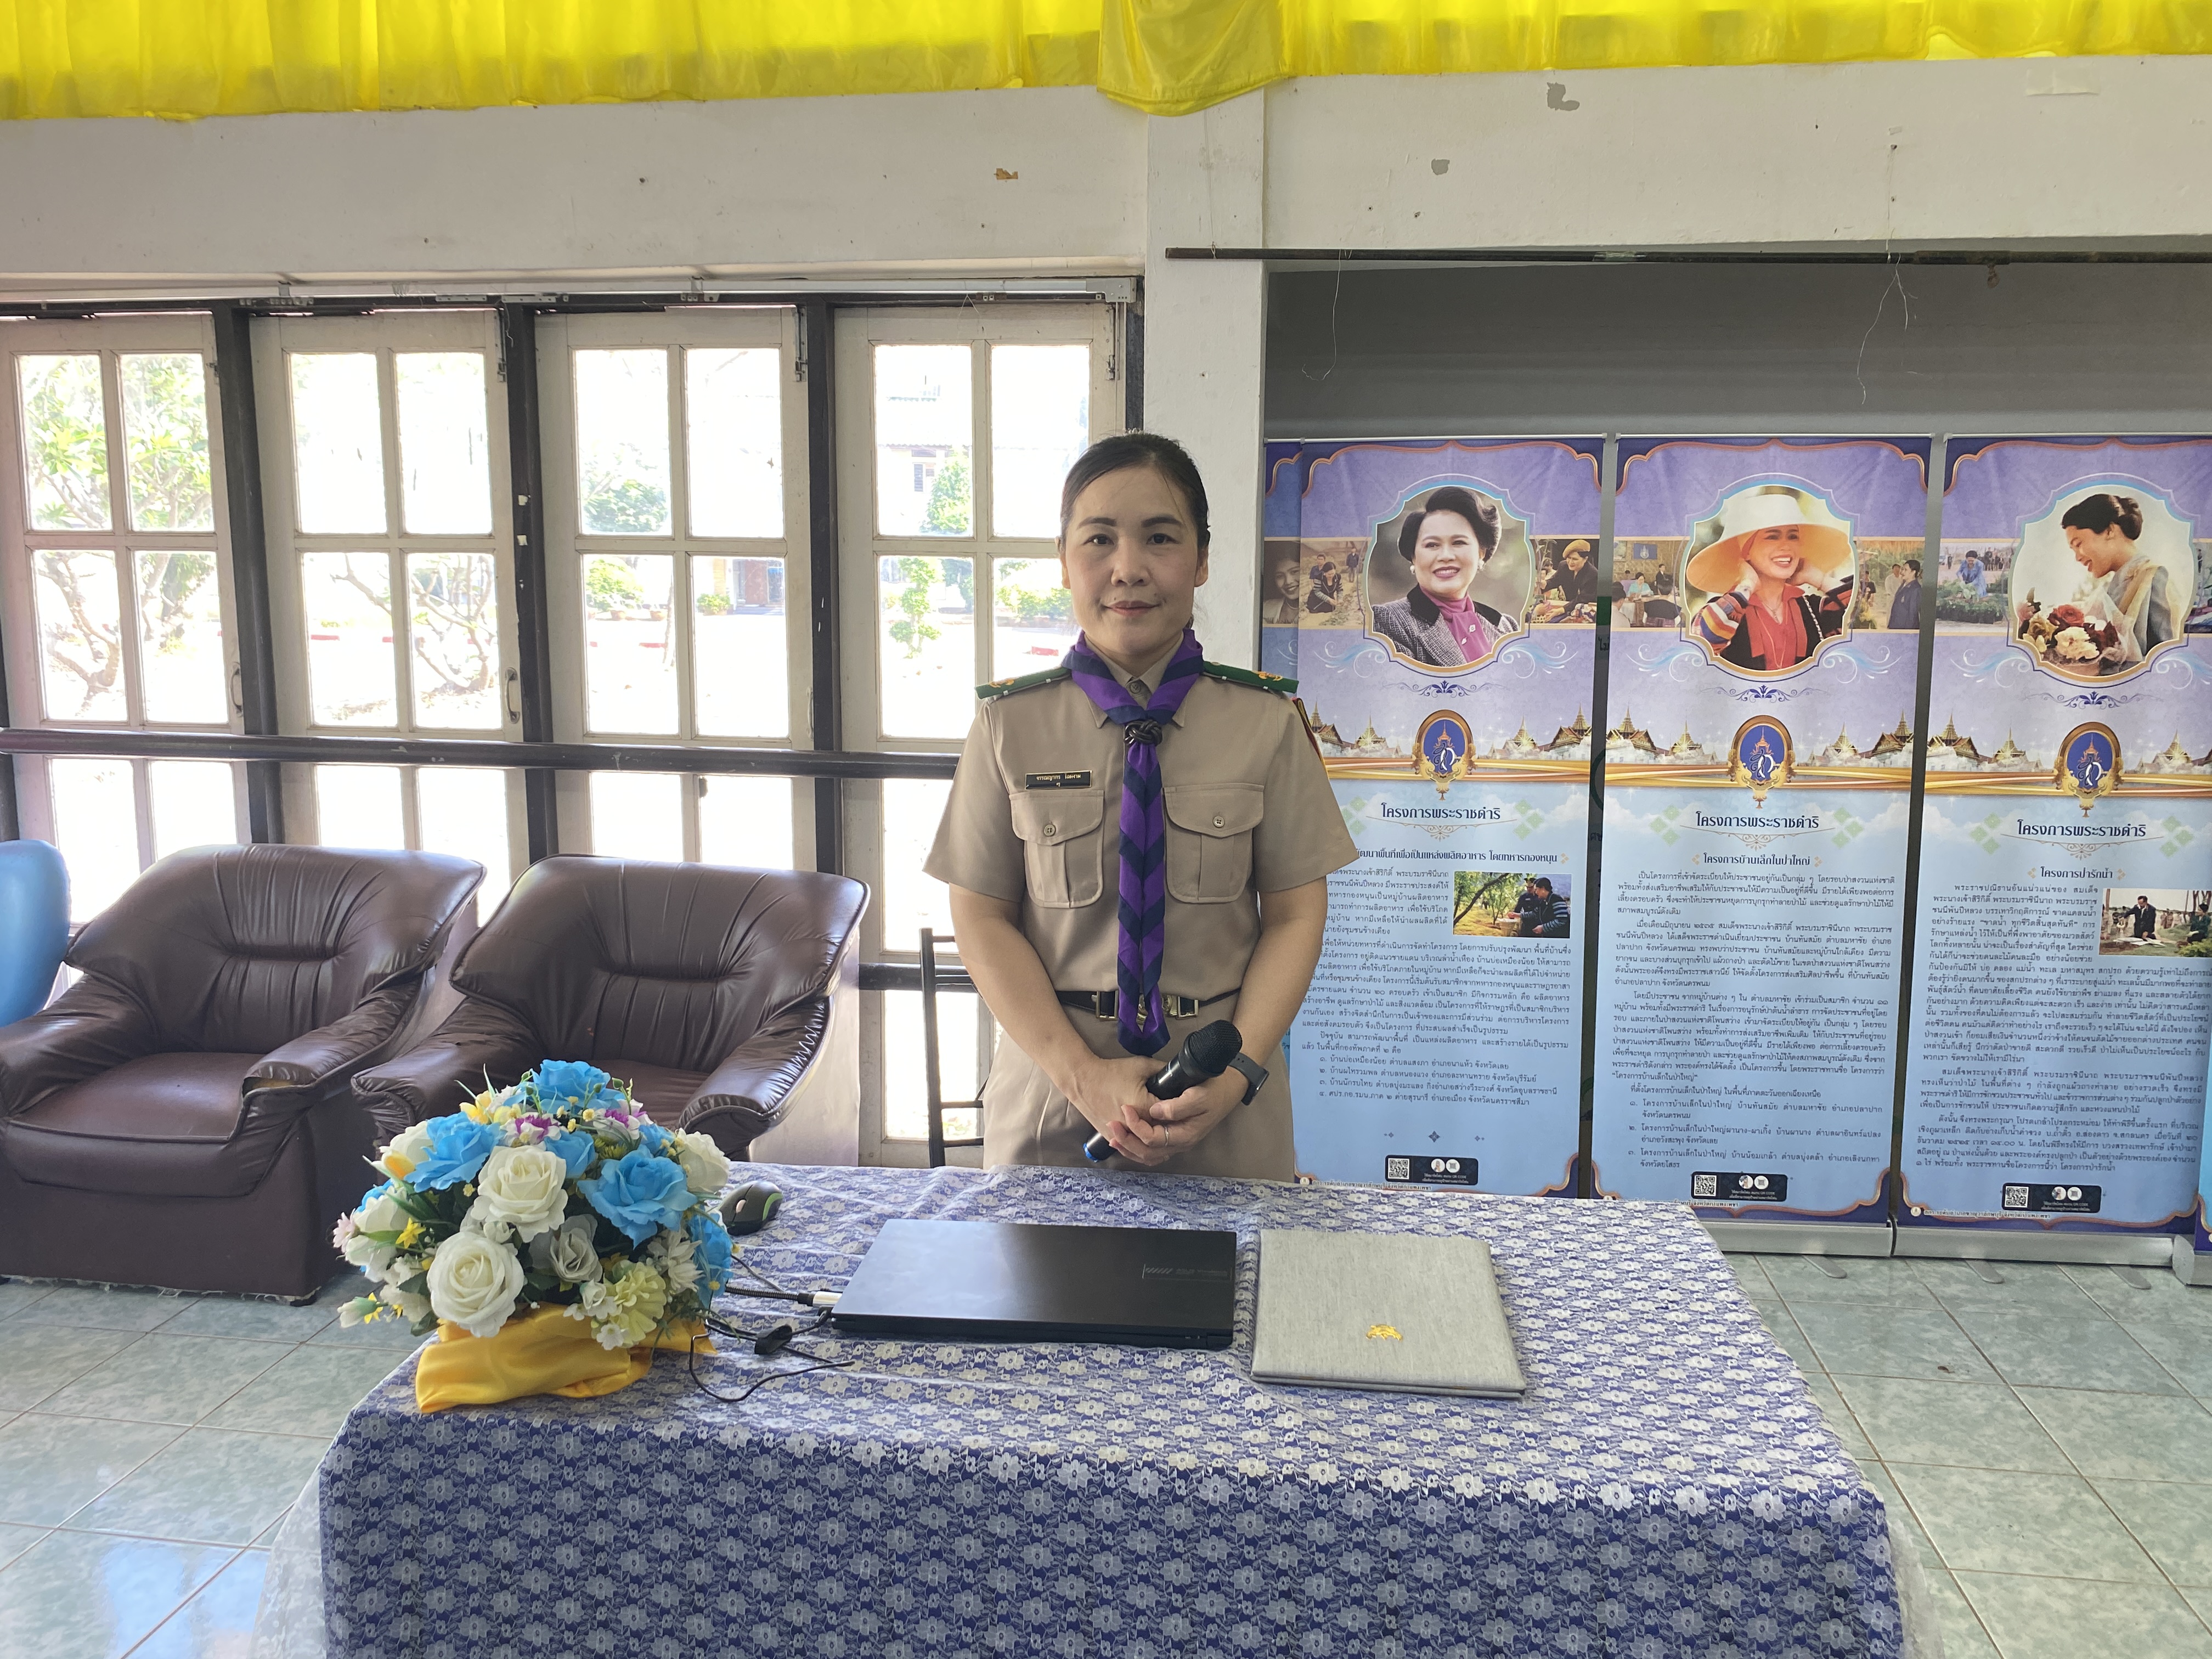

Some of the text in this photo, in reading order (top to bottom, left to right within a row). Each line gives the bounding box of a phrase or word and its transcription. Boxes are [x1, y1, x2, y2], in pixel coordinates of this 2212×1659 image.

[1381, 802, 1500, 820] โครงการพระราชดำริ
[1696, 811, 1819, 828] โครงการพระราชดำริ
[2017, 819, 2146, 837] โครงการพระราชดำริ
[1703, 853, 1810, 866] โครงการบ้านเล็กในป่าใหญ่
[2040, 866, 2113, 878] โครงการป่ารักน้ำ
[1301, 1041, 1314, 1050] แล้ว
